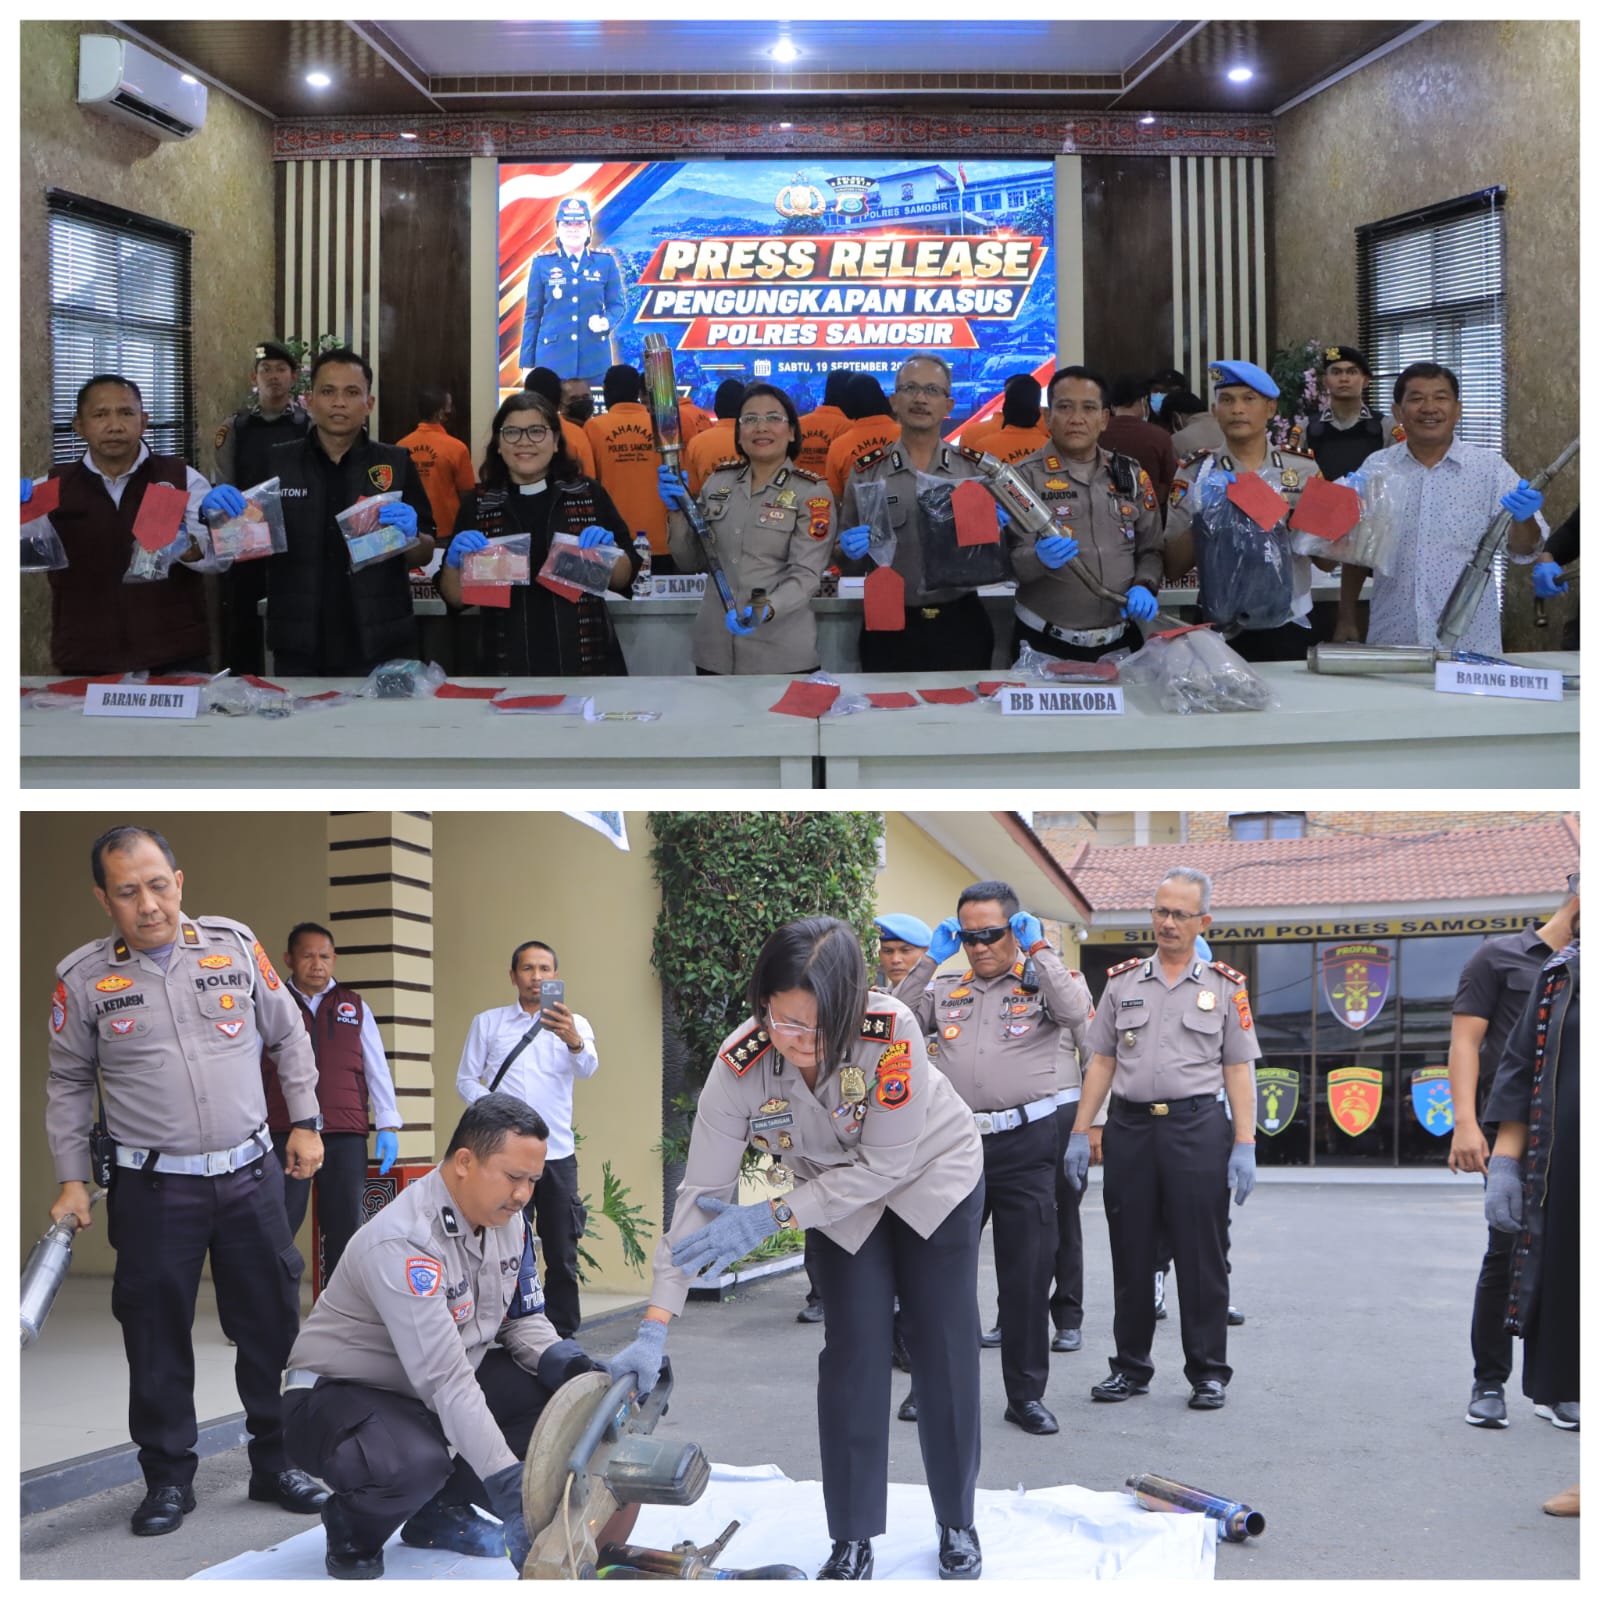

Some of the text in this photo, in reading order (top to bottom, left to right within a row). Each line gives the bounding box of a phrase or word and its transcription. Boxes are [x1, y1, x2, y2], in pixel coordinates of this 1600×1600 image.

[904, 202, 948, 215] SAMOSIR
[659, 240, 1032, 280] PRESS RELEASE
[653, 287, 1013, 315] PENGUNGKAPAN KASUS
[707, 322, 954, 346] POLRES SAMOSIR
[778, 362, 813, 373] SABTU,
[816, 362, 827, 372] 19
[831, 361, 888, 372] SEPTEMBER
[851, 437, 893, 456] TAHAN
[669, 579, 704, 593] KAPO
[1457, 671, 1549, 690] BARANG BUKTI
[102, 691, 184, 708] BARANG BUKTI
[1010, 692, 1117, 711] BB NARKOBA
[1277, 922, 1389, 937] POLRES
